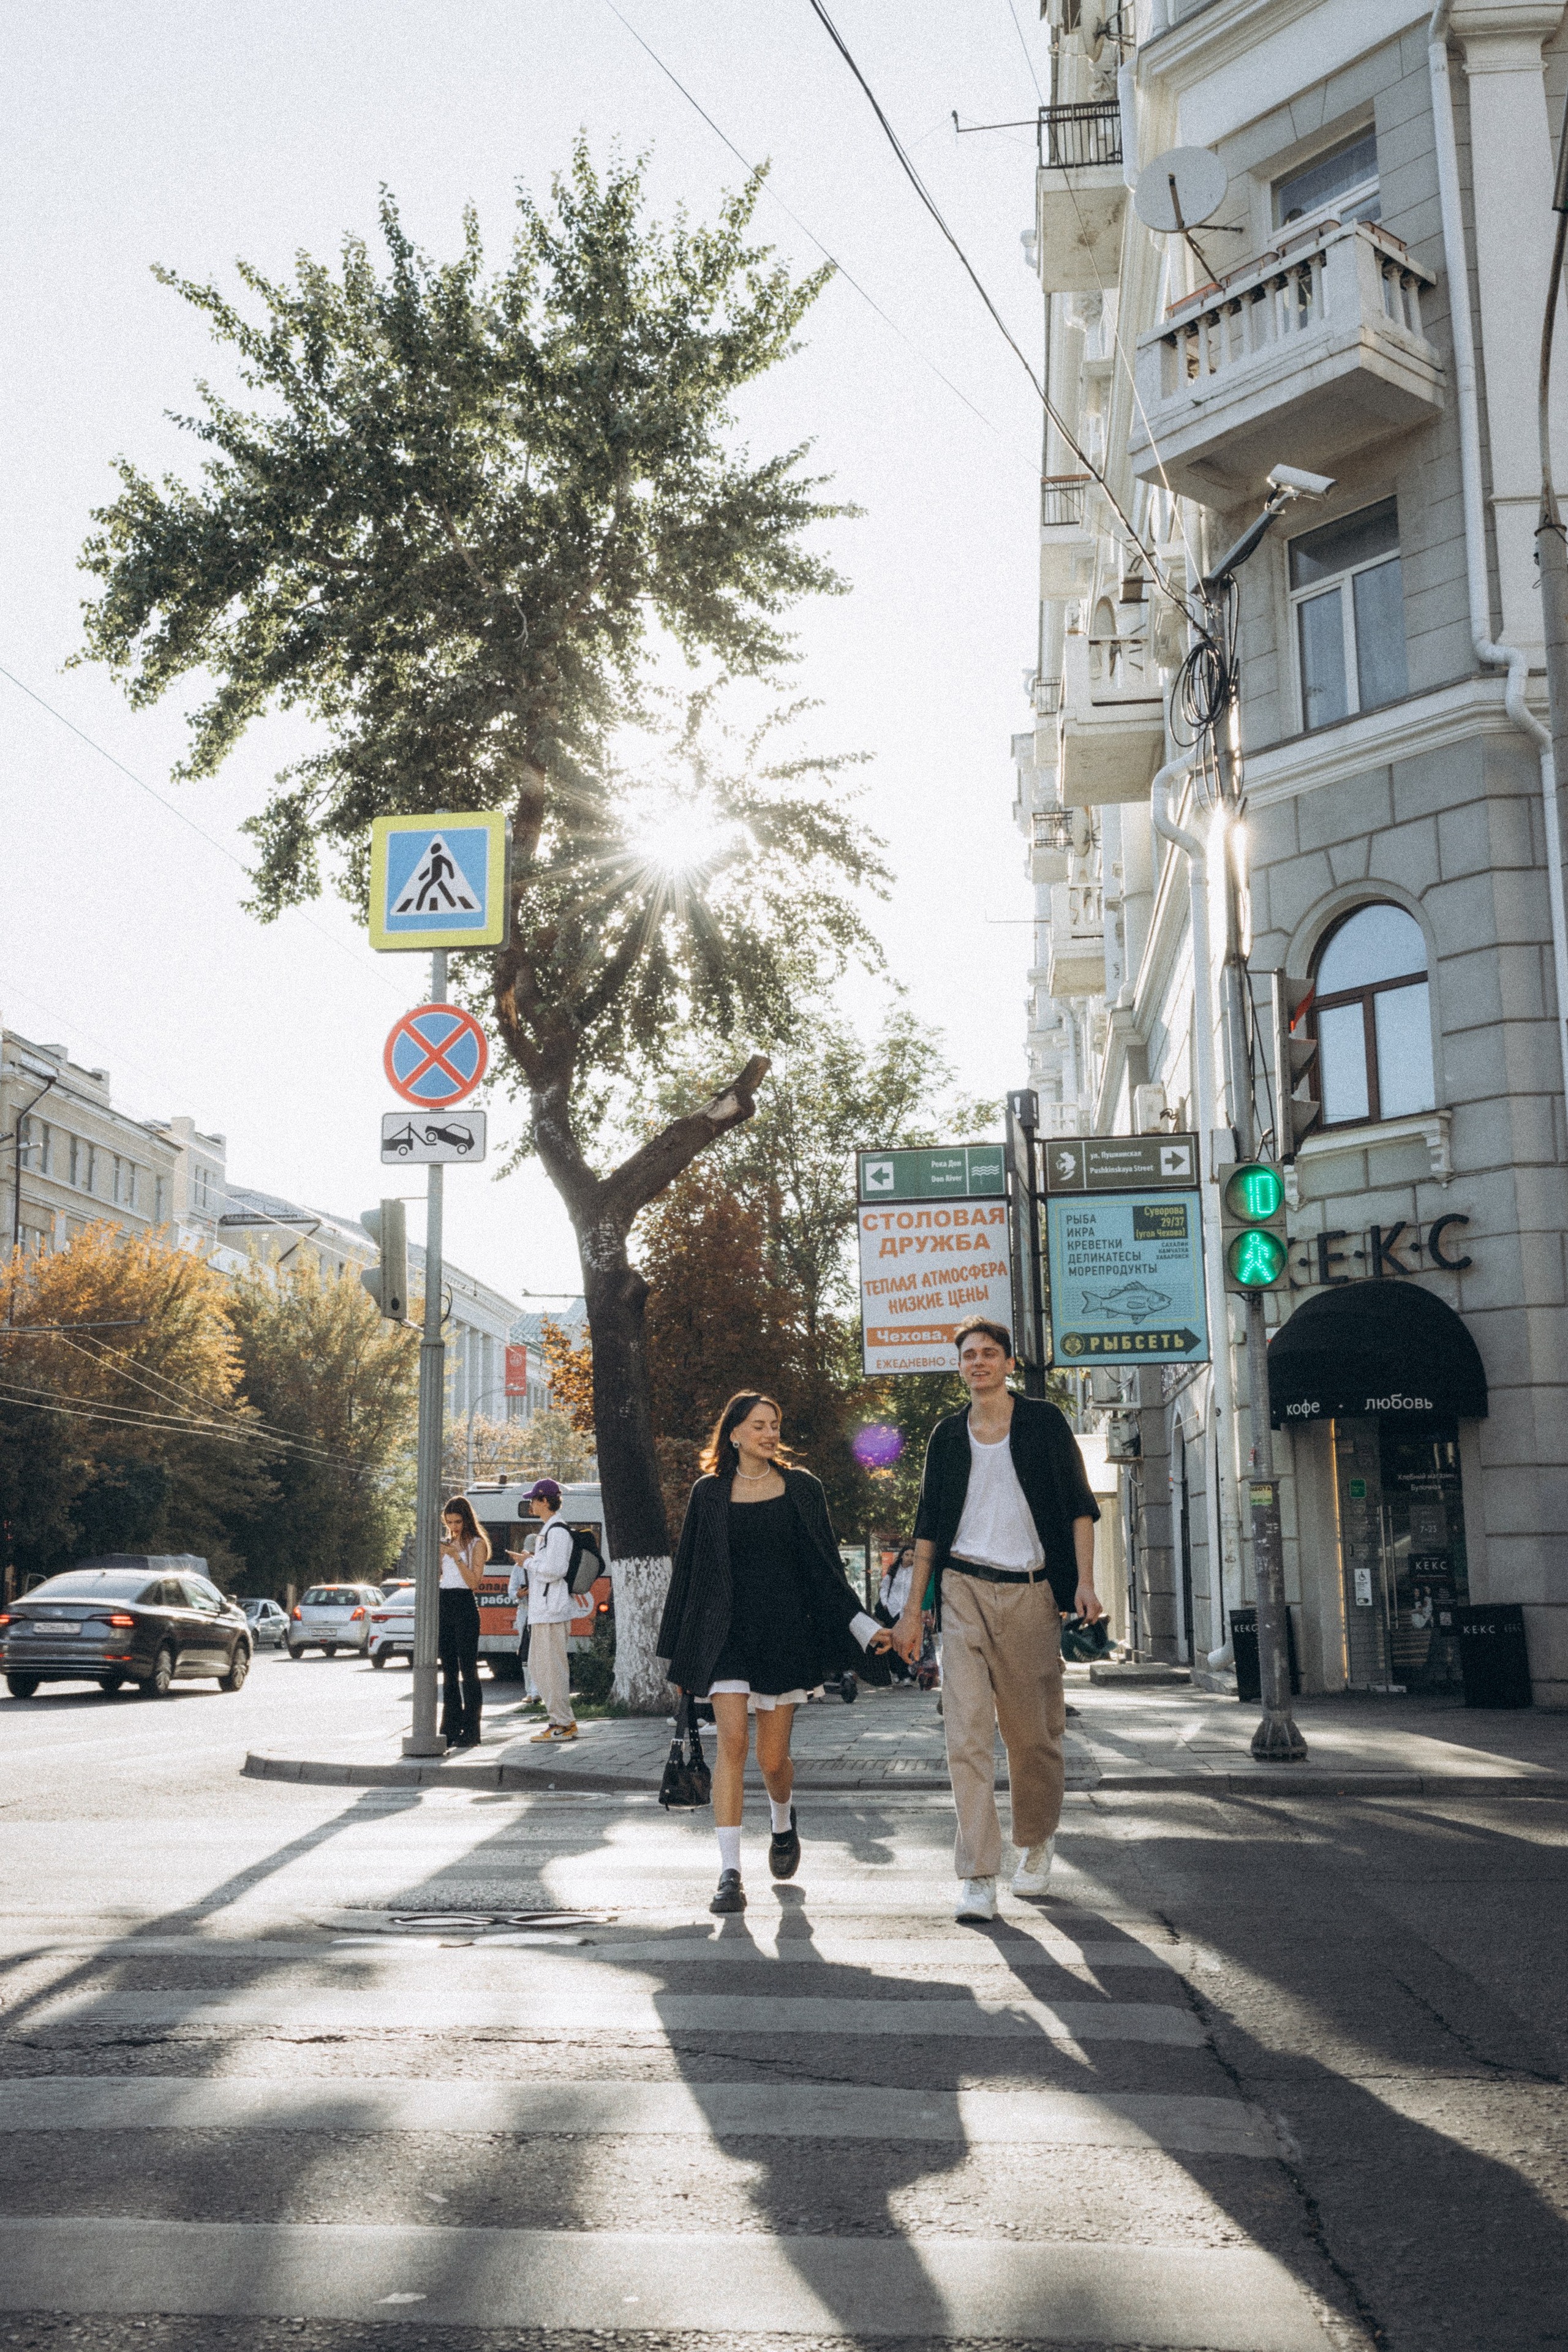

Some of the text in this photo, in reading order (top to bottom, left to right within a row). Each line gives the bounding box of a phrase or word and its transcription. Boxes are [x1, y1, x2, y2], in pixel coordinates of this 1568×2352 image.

[1102, 1151, 1142, 1159] Пушкинская
[948, 1159, 962, 1168] Дон
[1090, 1164, 1154, 1175] Pushkinskaya Street
[946, 1174, 962, 1182] River
[1144, 1206, 1184, 1218] Суворова
[862, 1207, 1005, 1232] СТОЛОВАЯ
[1066, 1214, 1097, 1225] РЫБА
[1161, 1217, 1185, 1227] 29/37
[1067, 1227, 1095, 1238] ИКРА
[878, 1232, 990, 1259] ДРУЖБА
[1067, 1238, 1123, 1251] КРЕВЕТКИ
[1068, 1251, 1142, 1265] ДЕЛИКАТЕСЫ
[1068, 1264, 1158, 1277] МОРЕПРОДУКТЫ
[863, 1261, 1008, 1296] ТЕПЛАЯ АТМОСФЕРА
[889, 1284, 989, 1314] НИЗКИЕ ЦЕНЫ
[876, 1330, 948, 1343] Чехова,
[1090, 1333, 1185, 1351] РЫБСЕТЬ
[876, 1357, 946, 1370] ЕЖЕДНЕВНО
[1286, 1393, 1433, 1418] кофе любовь
